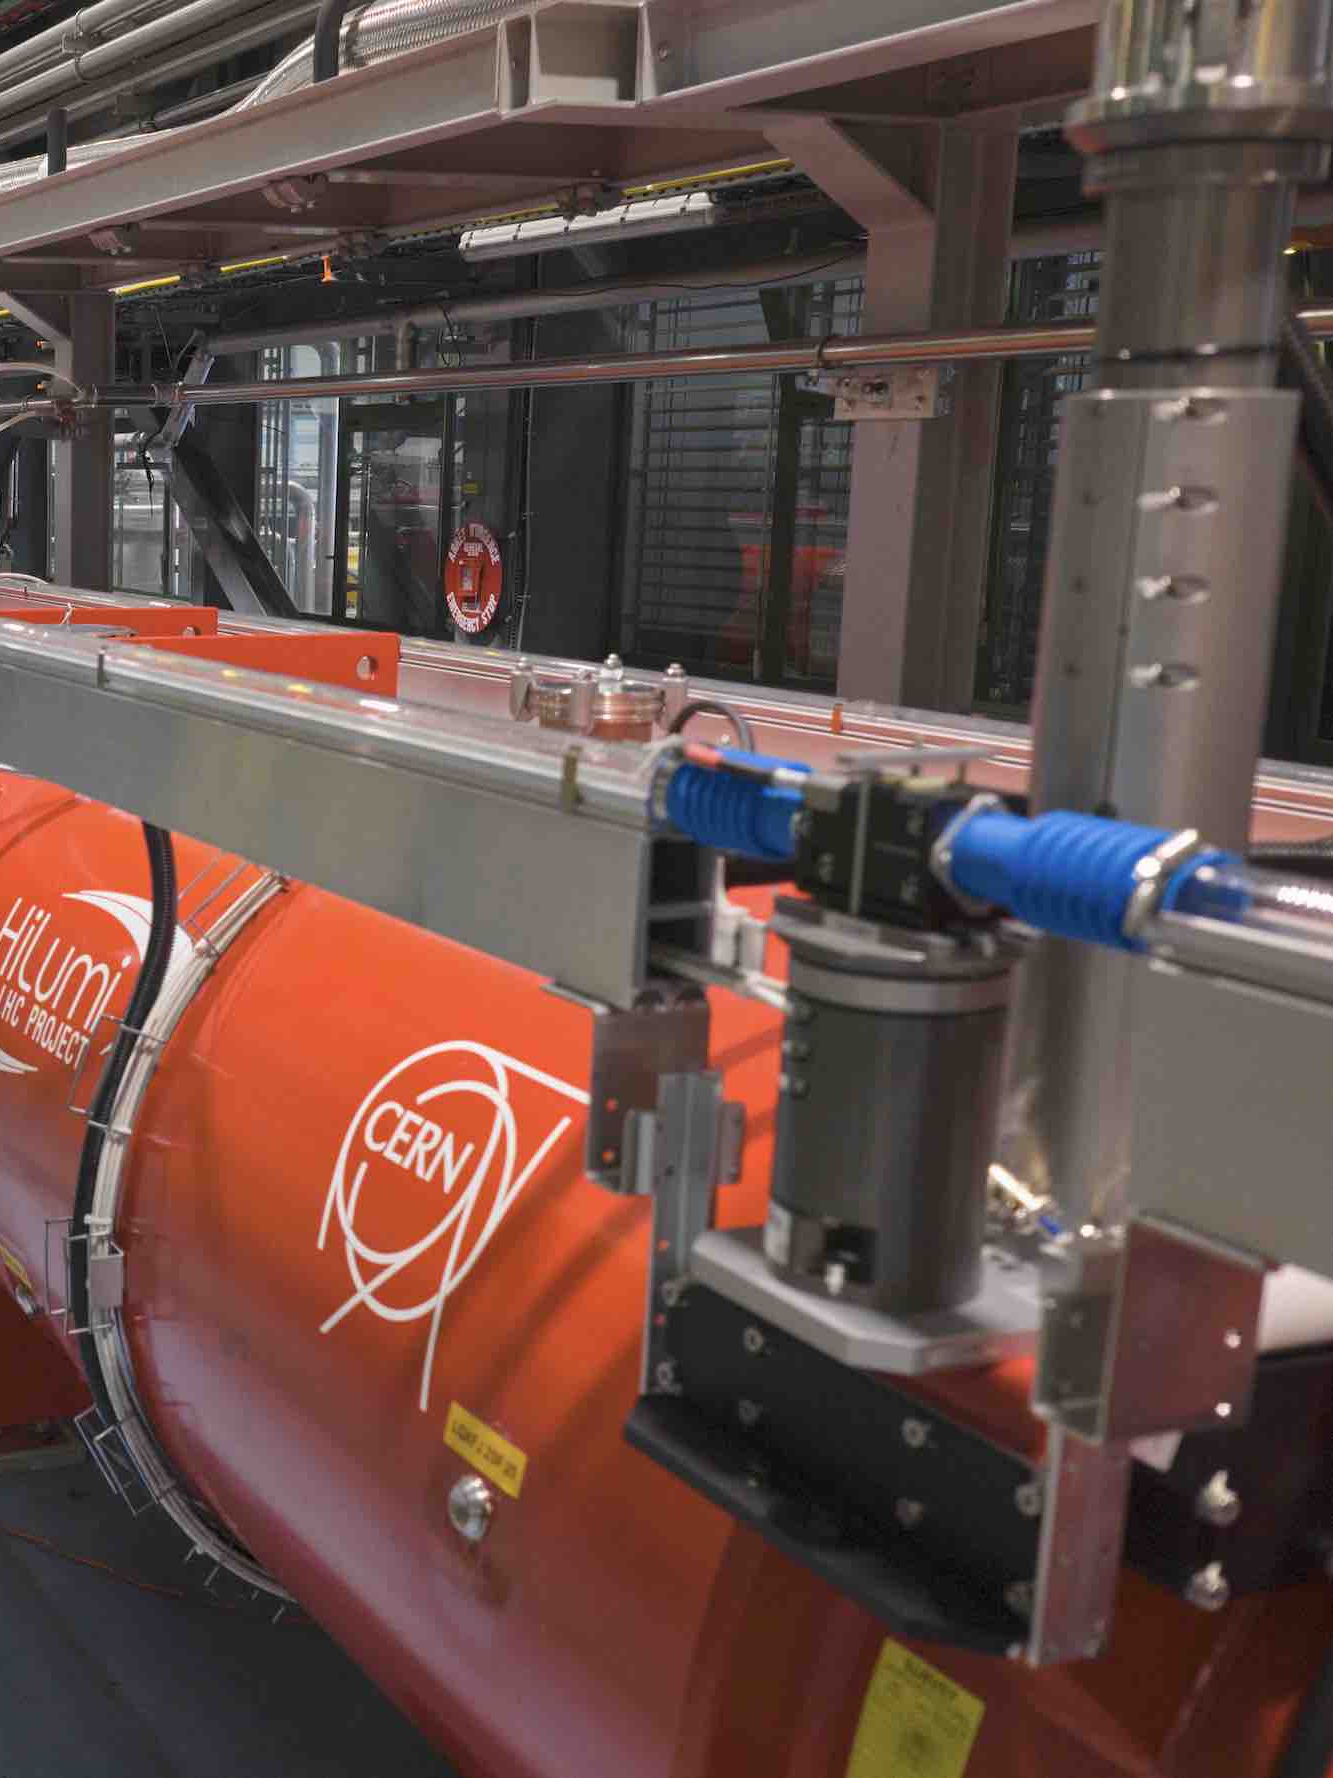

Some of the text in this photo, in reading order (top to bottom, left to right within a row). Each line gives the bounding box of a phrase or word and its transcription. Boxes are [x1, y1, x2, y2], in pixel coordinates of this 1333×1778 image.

[446, 591, 498, 632] EMERGENCY STOP
[22, 1004, 90, 1070] PROJECT
[364, 1100, 475, 1195] CERN
